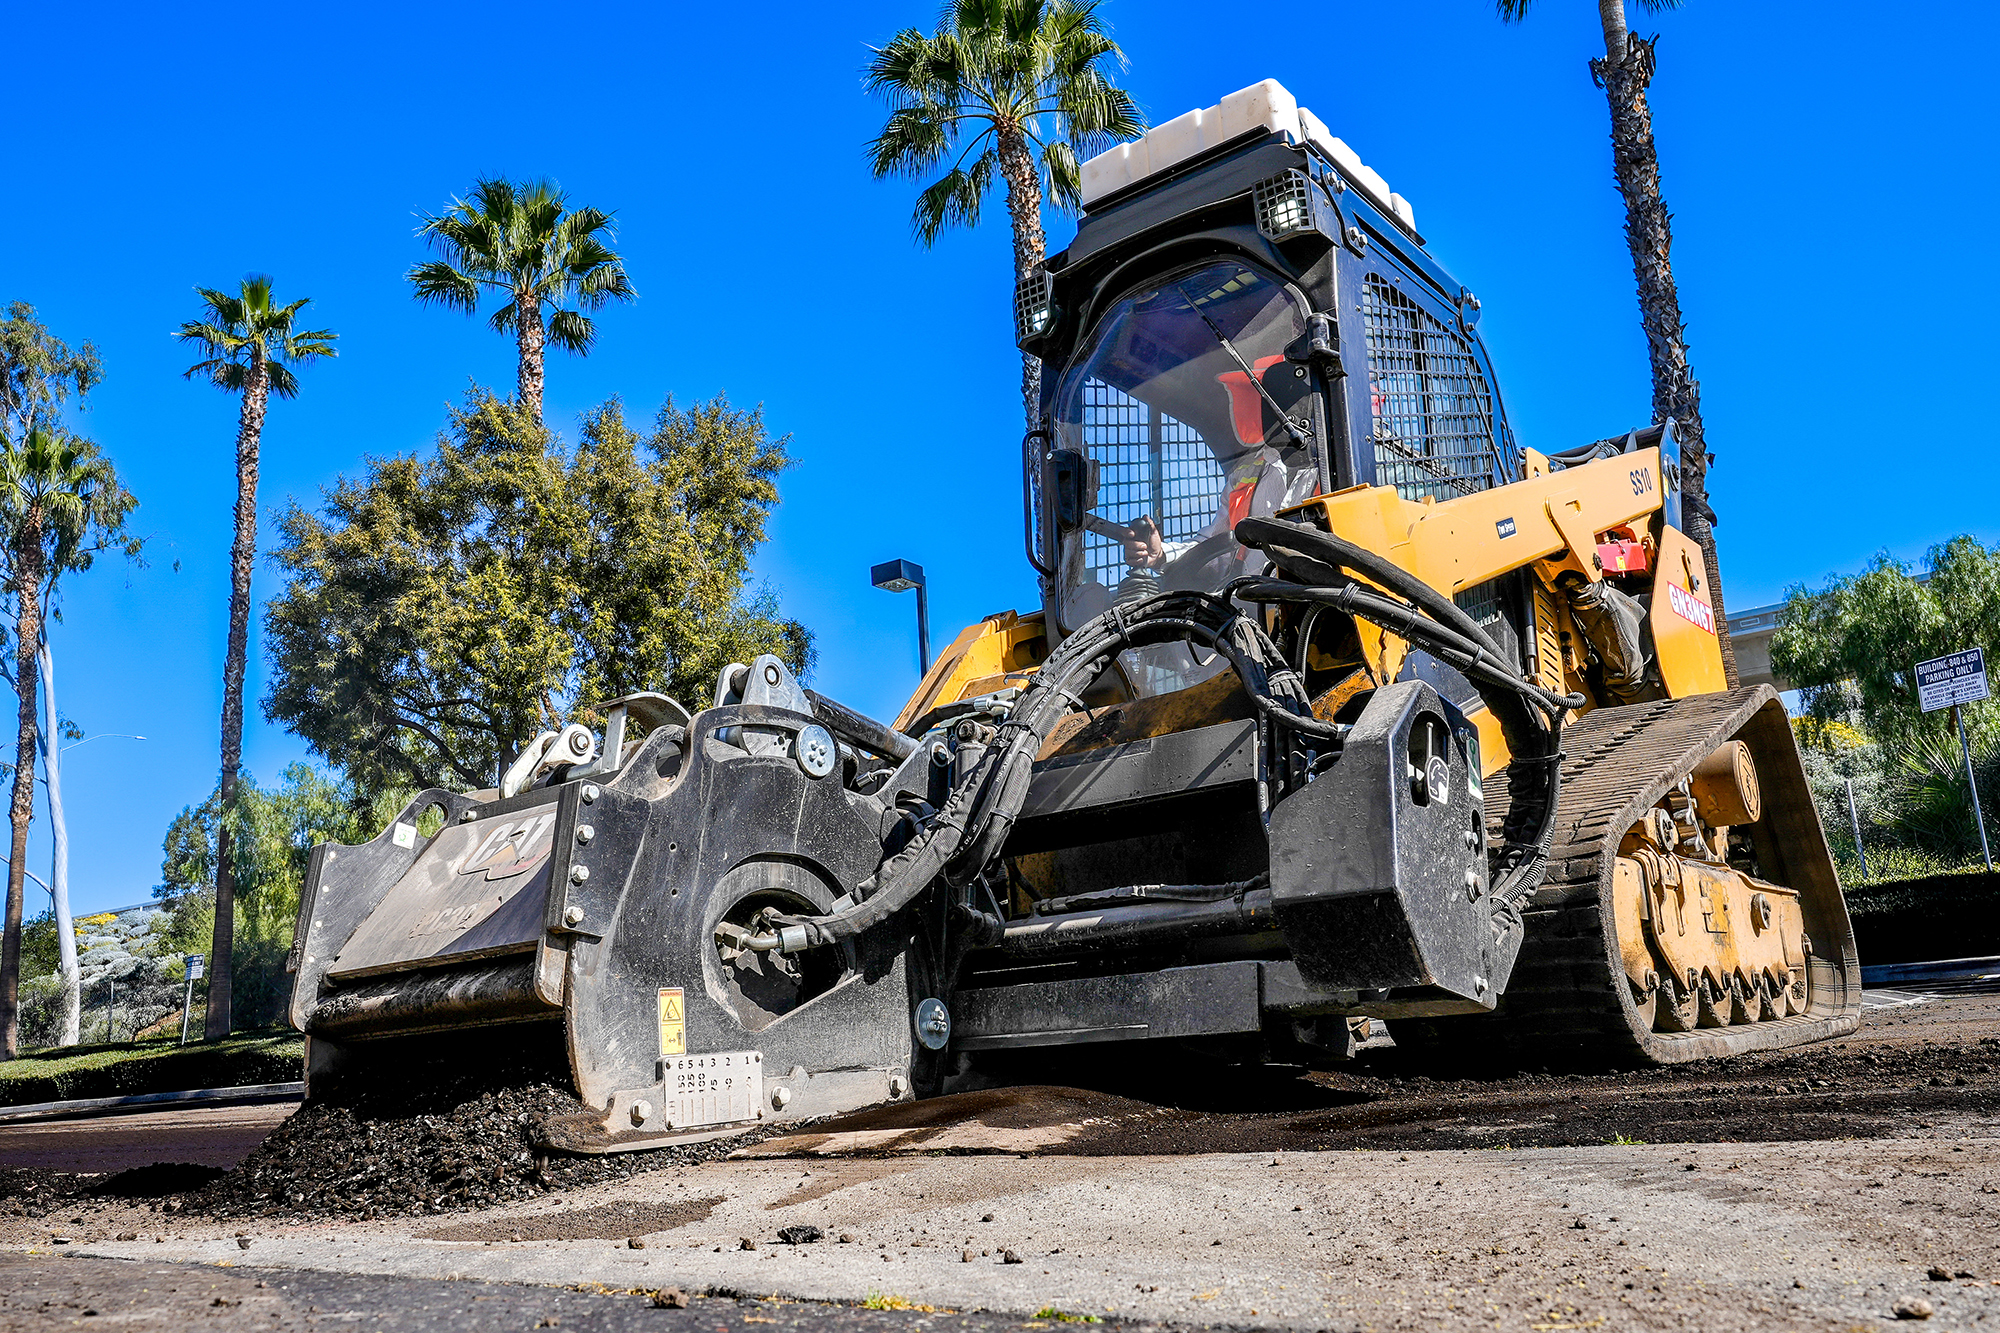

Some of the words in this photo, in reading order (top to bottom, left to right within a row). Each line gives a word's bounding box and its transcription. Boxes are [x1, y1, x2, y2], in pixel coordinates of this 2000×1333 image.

[1630, 467, 1652, 496] SS10
[1918, 660, 1948, 675] BUILDING
[1948, 657, 1960, 667] 840
[1961, 656, 1966, 664] &
[1966, 652, 1978, 662] 850
[1925, 669, 1955, 683] PARKING
[1956, 664, 1974, 676] ONLY
[464, 812, 557, 871] CAT
[678, 1060, 684, 1070] 6
[688, 1059, 694, 1069] 5
[698, 1058, 704, 1068] 4
[710, 1058, 716, 1068] 3
[725, 1057, 730, 1066] 2
[745, 1056, 750, 1064] 1
[678, 1074, 686, 1094] 150
[698, 1072, 706, 1094] 100
[710, 1079, 718, 1092] 75
